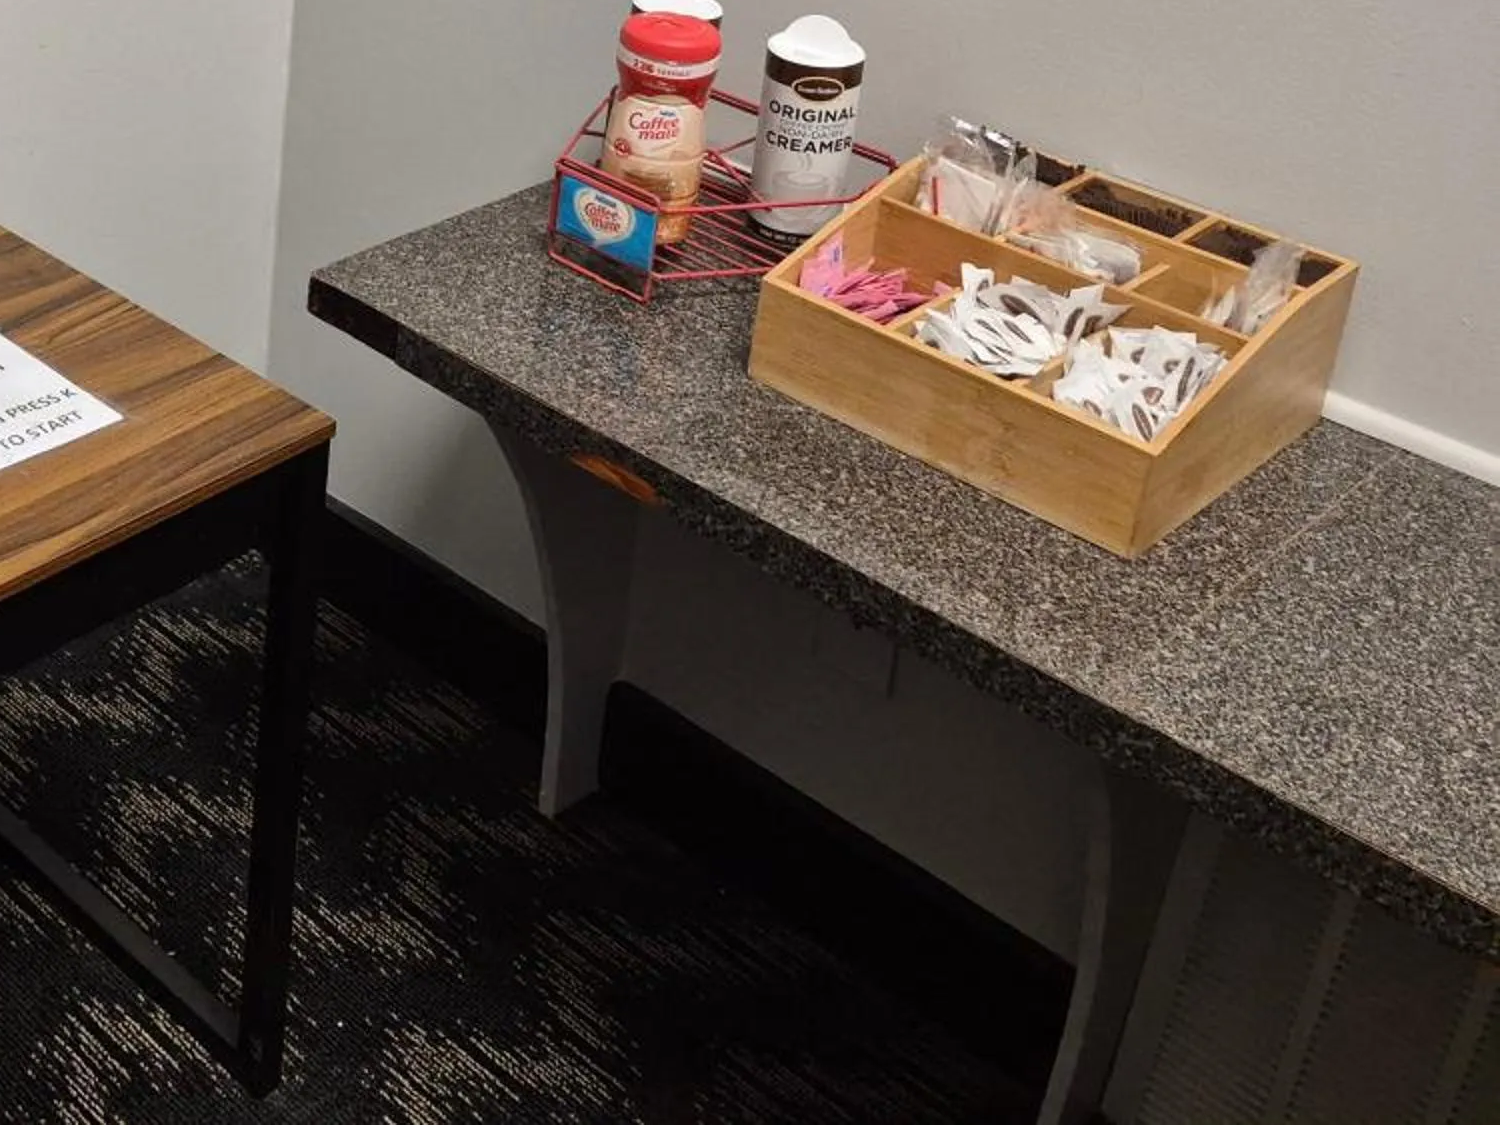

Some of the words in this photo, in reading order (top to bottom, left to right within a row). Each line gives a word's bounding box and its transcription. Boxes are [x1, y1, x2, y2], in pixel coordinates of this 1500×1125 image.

[629, 112, 679, 130] Coffee
[769, 100, 856, 123] ORIGINAL
[765, 130, 852, 154] CREAMER
[5, 394, 62, 418] PRESS
[60, 388, 77, 399] K
[26, 410, 83, 438] START
